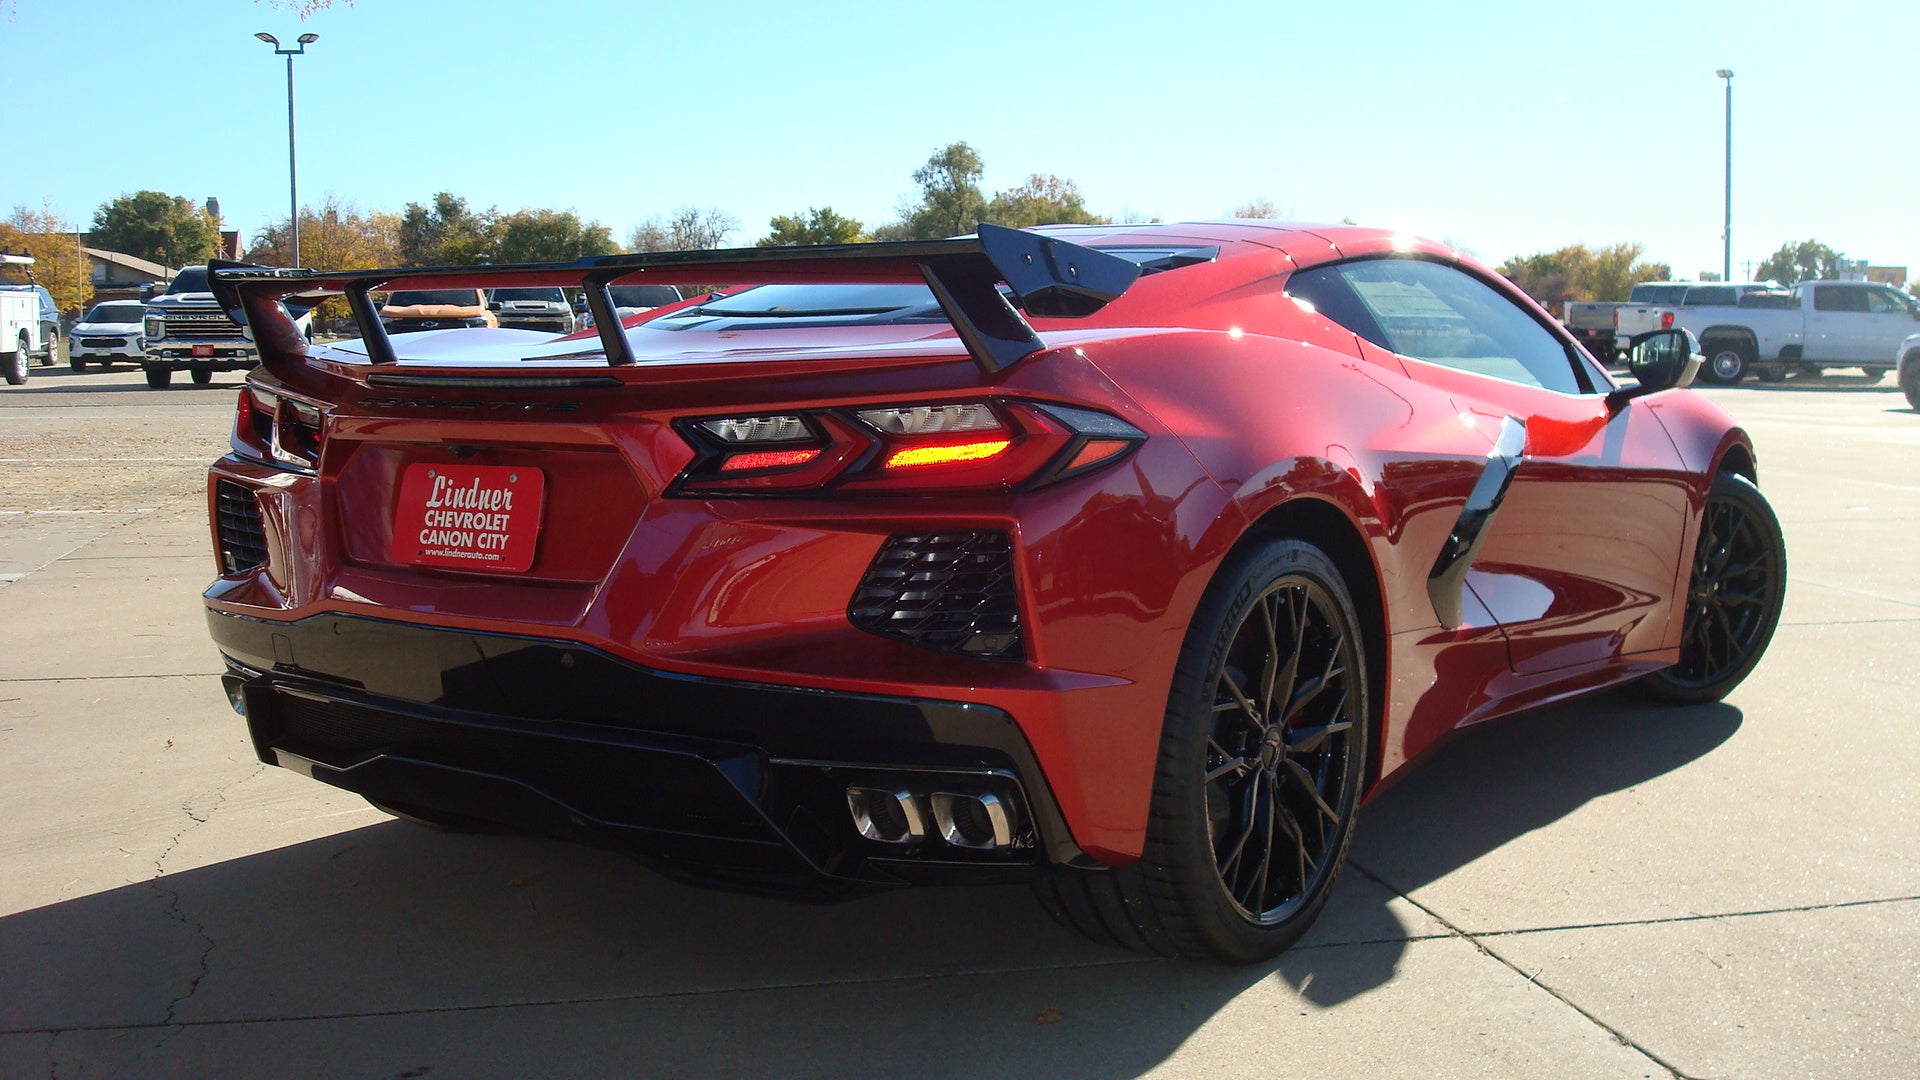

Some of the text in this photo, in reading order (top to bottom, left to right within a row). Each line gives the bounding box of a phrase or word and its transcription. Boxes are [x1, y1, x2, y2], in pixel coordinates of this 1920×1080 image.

[425, 475, 513, 511] Lindner
[425, 510, 510, 531] CHEVROLET
[419, 528, 509, 550] CANON CITY
[425, 548, 500, 561] www.lindnerauto.com
